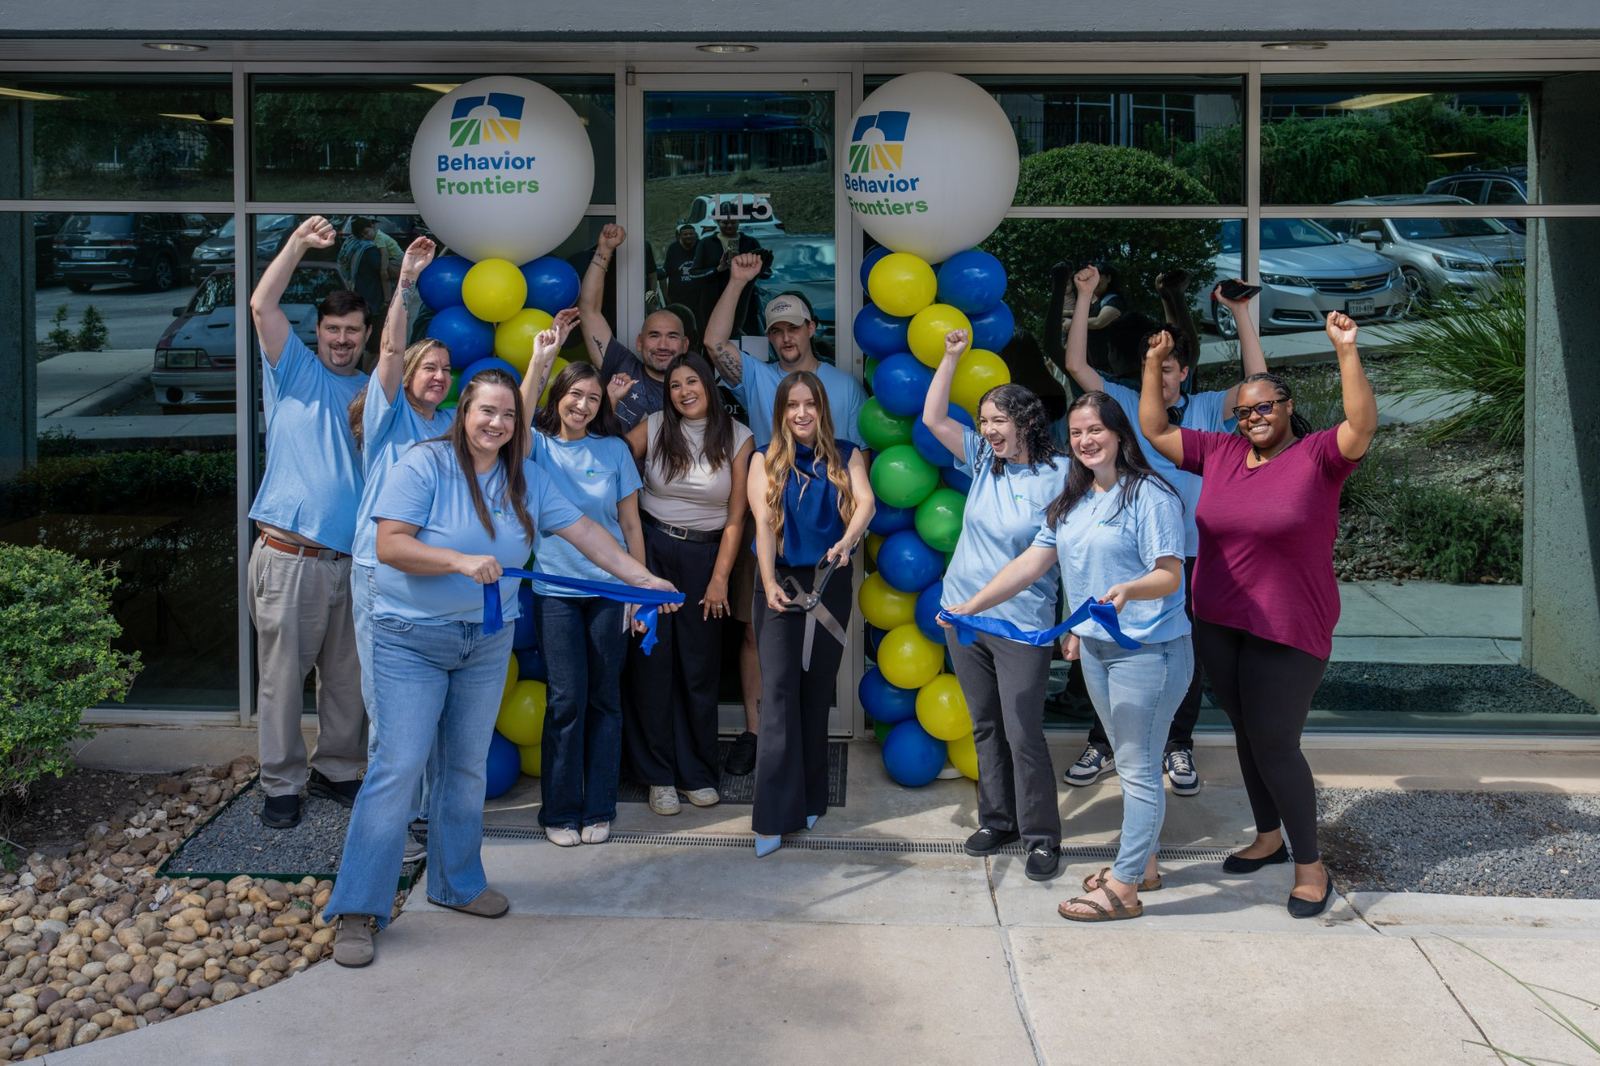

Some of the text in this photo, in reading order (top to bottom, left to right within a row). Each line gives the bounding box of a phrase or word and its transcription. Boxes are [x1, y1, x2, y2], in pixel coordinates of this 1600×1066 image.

[437, 150, 536, 172] Behavior
[436, 175, 540, 195] Frontiers
[844, 173, 920, 193] Behavior
[708, 193, 773, 220] 115
[848, 196, 929, 215] Frontiers
